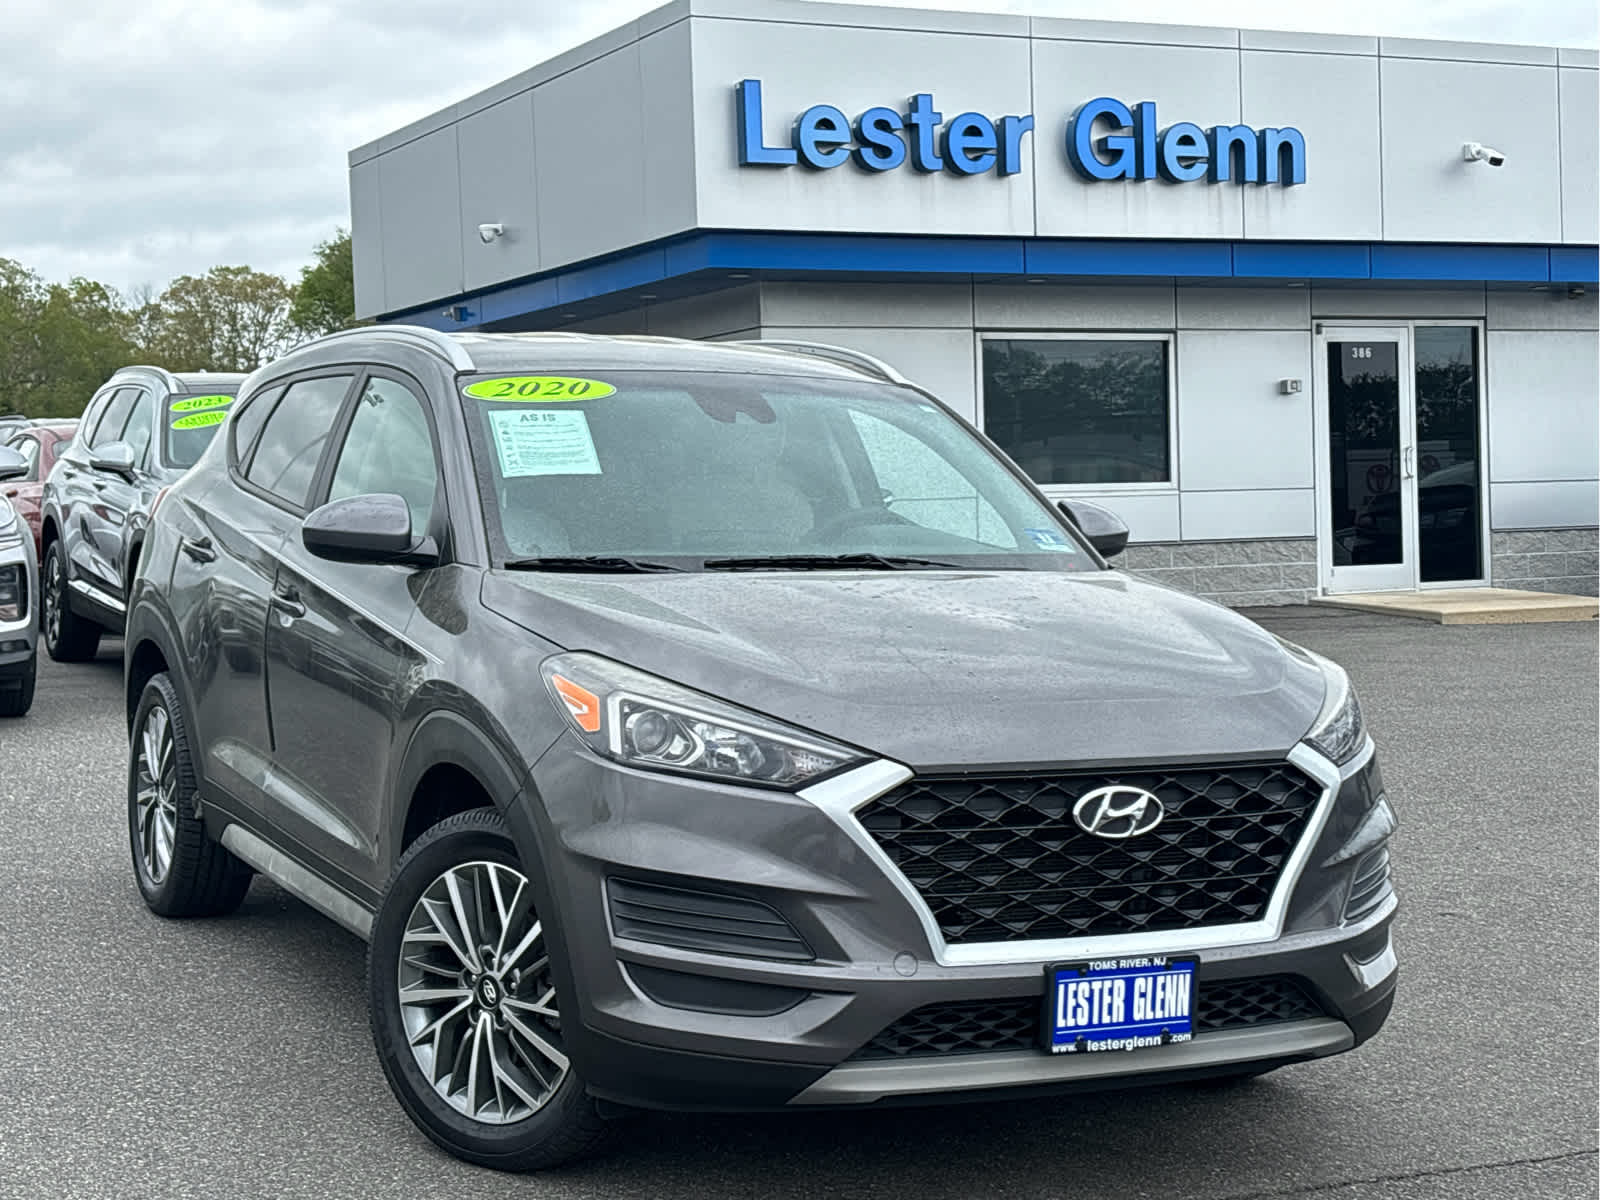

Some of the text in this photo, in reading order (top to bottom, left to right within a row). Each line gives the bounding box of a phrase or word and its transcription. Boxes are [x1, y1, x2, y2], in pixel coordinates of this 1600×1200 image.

[735, 79, 1307, 185] Lester Glenn
[1351, 347, 1372, 359] 386
[491, 381, 591, 397] 2020
[519, 413, 557, 423] AS IS
[1088, 960, 1118, 972] TOMS
[1153, 956, 1168, 967] NJ
[1056, 973, 1191, 1027] LESTER GLENN
[1087, 1035, 1162, 1051] lesterglenn
